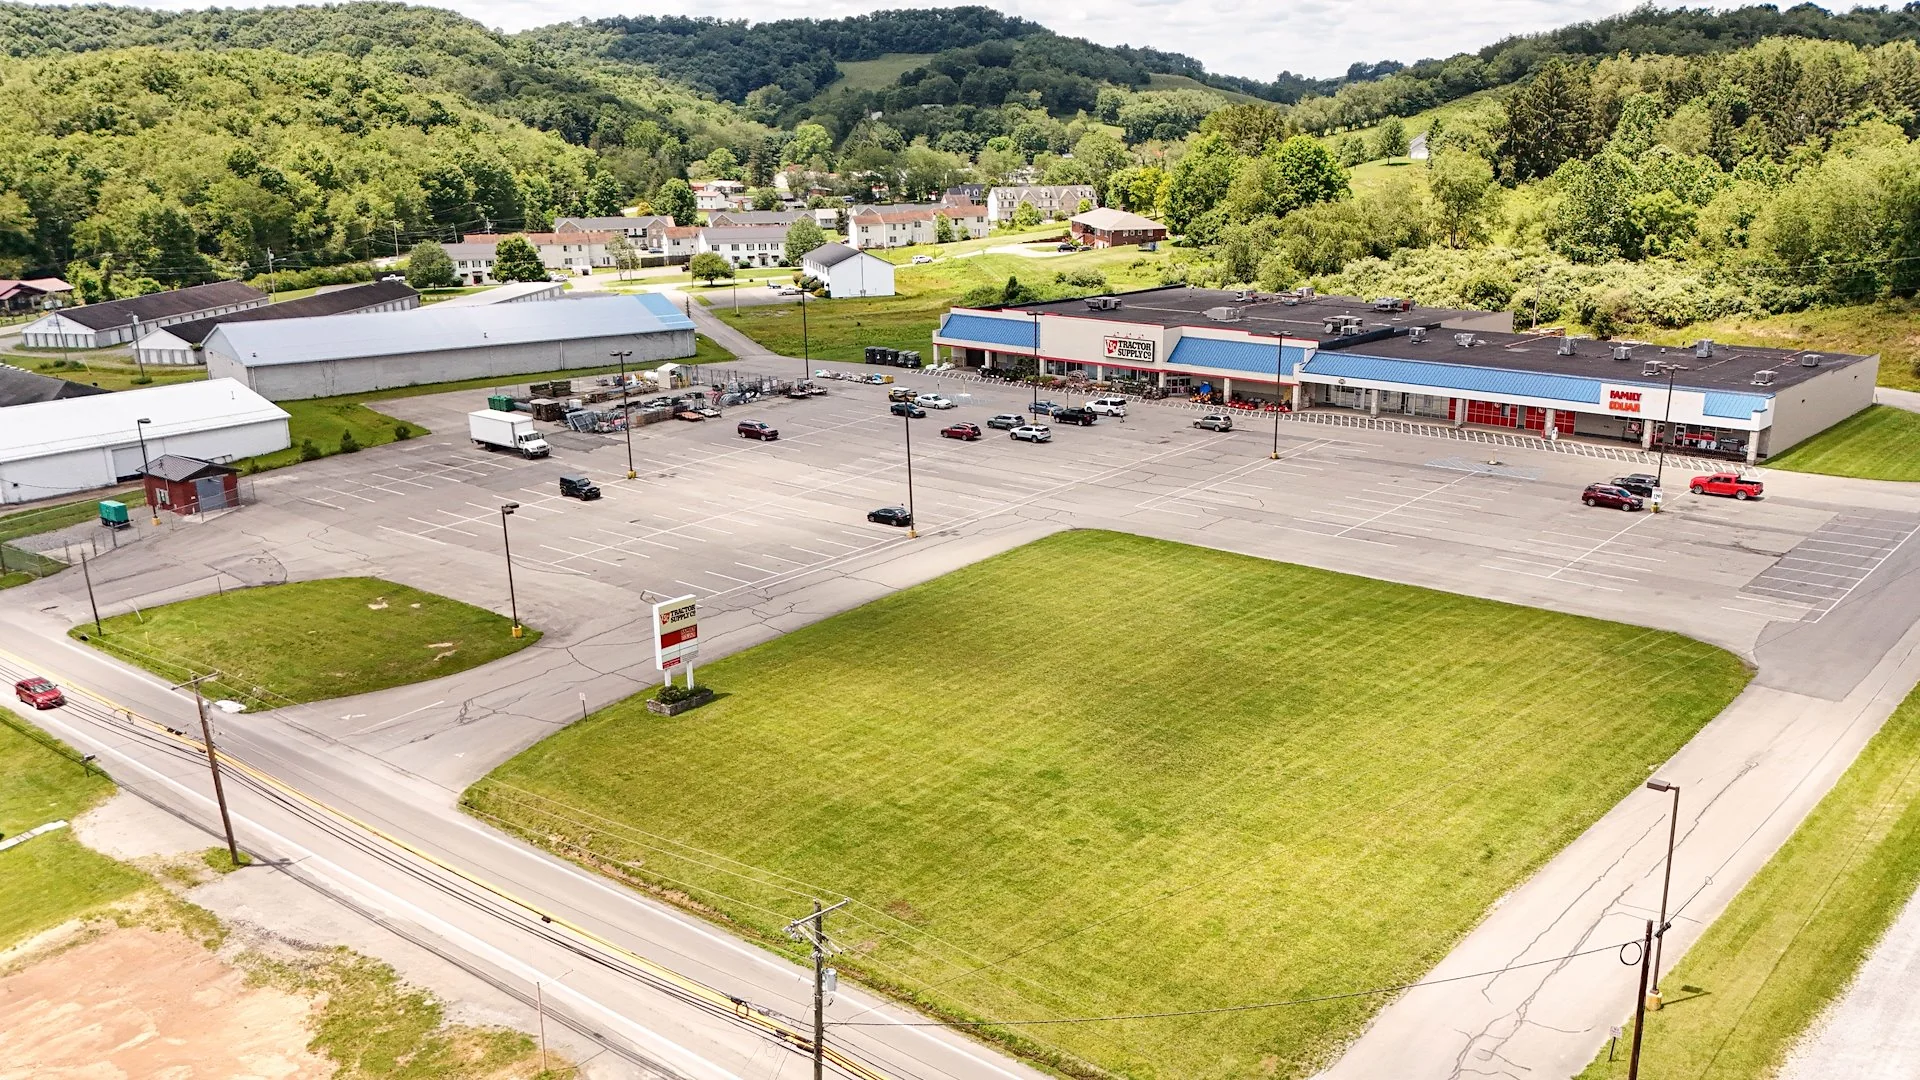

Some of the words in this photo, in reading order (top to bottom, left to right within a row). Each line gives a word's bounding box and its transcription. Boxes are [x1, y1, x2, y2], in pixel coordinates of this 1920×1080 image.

[1118, 340, 1151, 351] TRACTOR
[1118, 348, 1143, 358] SUPPLY
[1610, 390, 1642, 401] FAMILY
[670, 604, 696, 616] TRACTOR
[670, 612, 690, 623] SUPPLY
